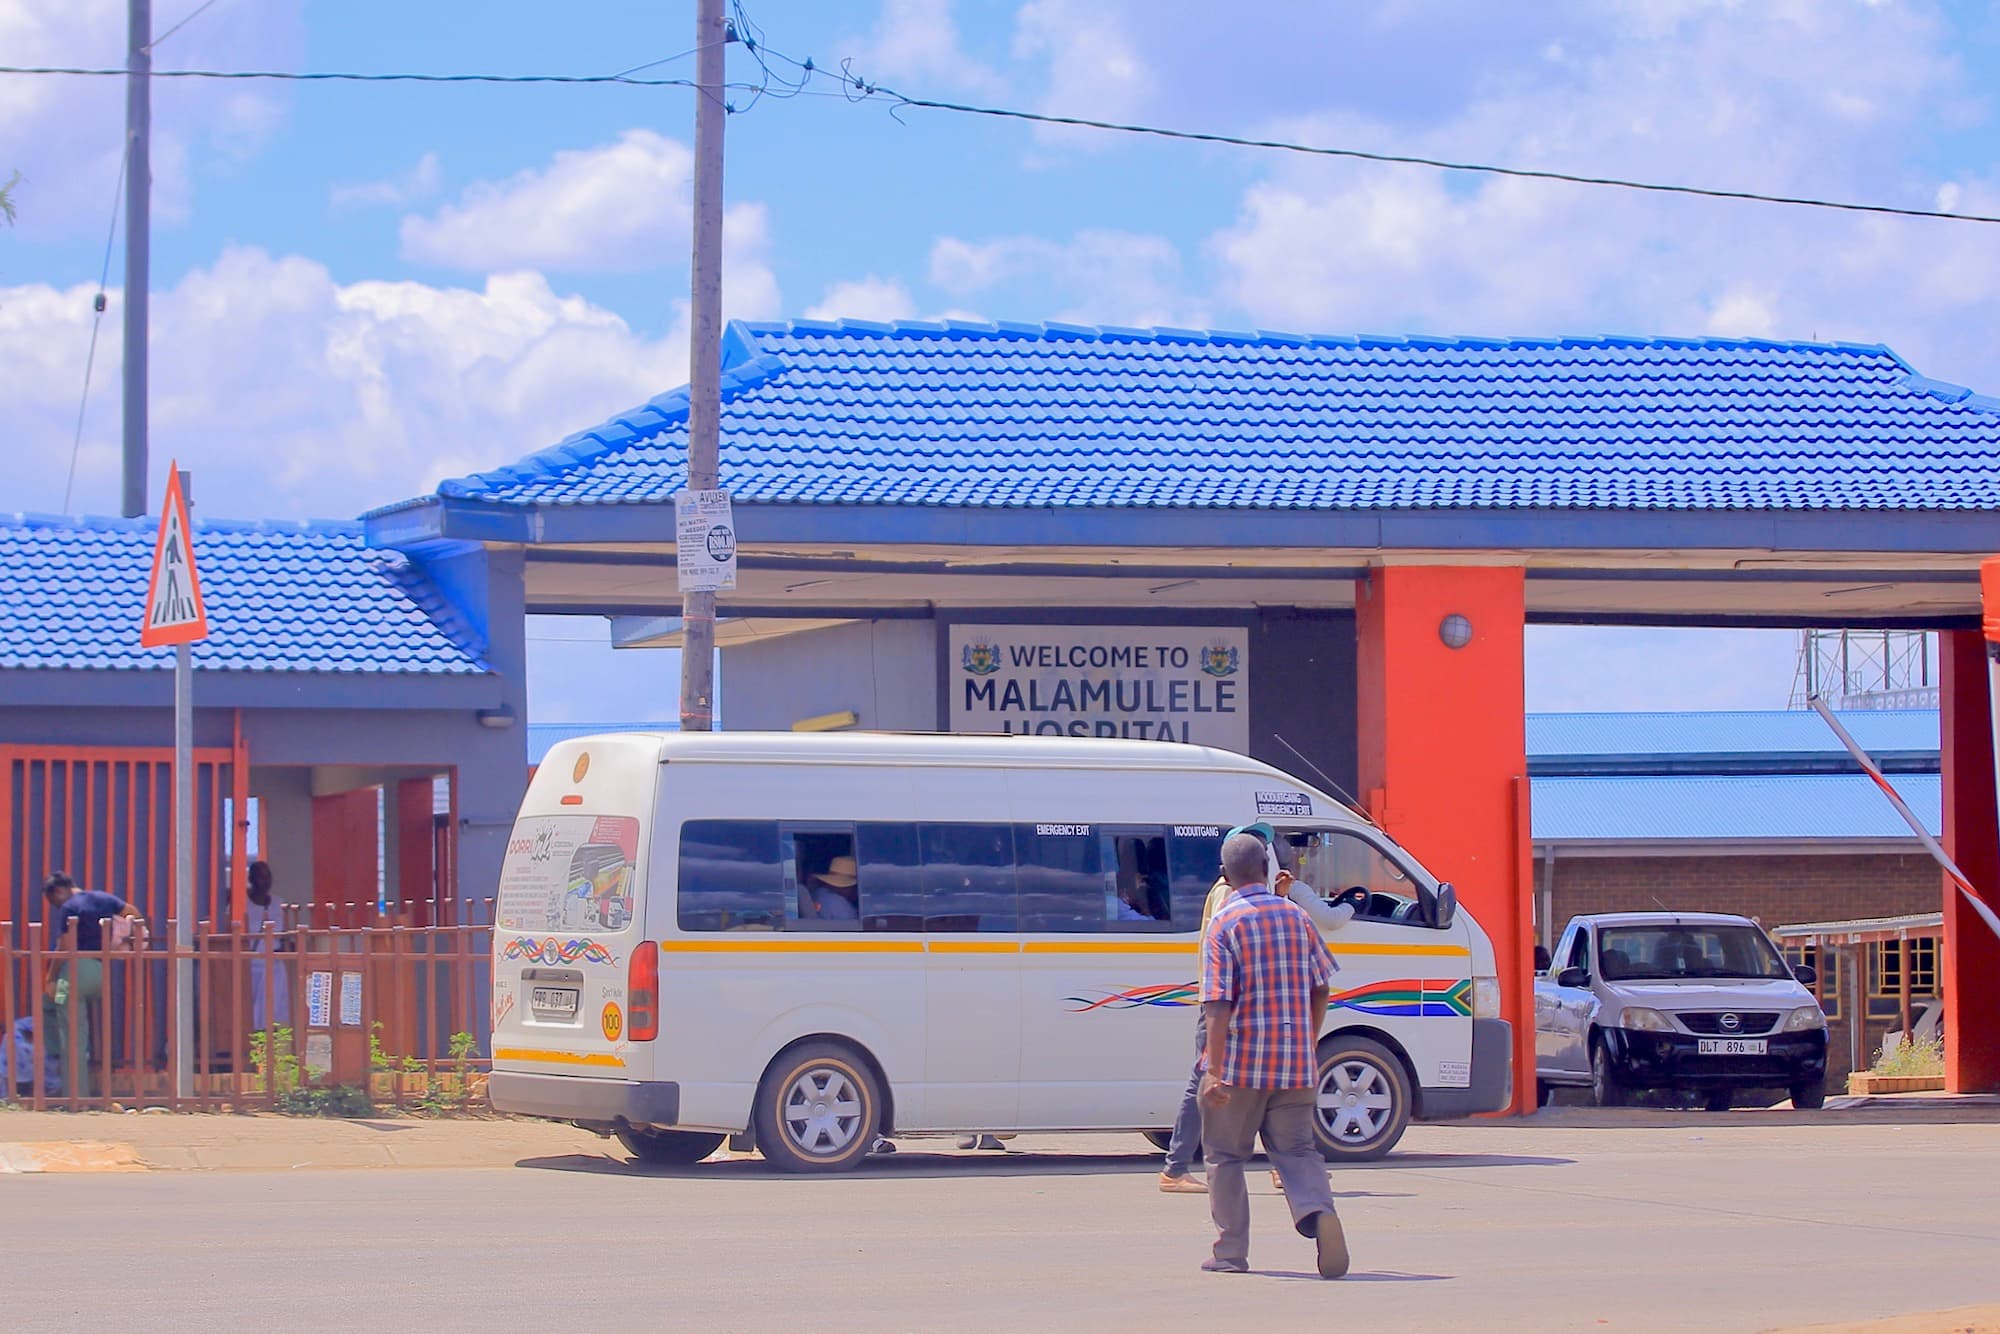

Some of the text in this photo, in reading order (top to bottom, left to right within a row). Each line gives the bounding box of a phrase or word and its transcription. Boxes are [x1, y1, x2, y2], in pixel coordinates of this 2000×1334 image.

[1009, 645, 1189, 669] WELCOME TO
[965, 678, 1237, 713] MALAMULELE
[1036, 824, 1090, 836] EMERGENCY EXIT
[1174, 825, 1220, 837] NOODUITGANG
[604, 1013, 620, 1030] 100
[1700, 1041, 1765, 1053] DLT 896 L
